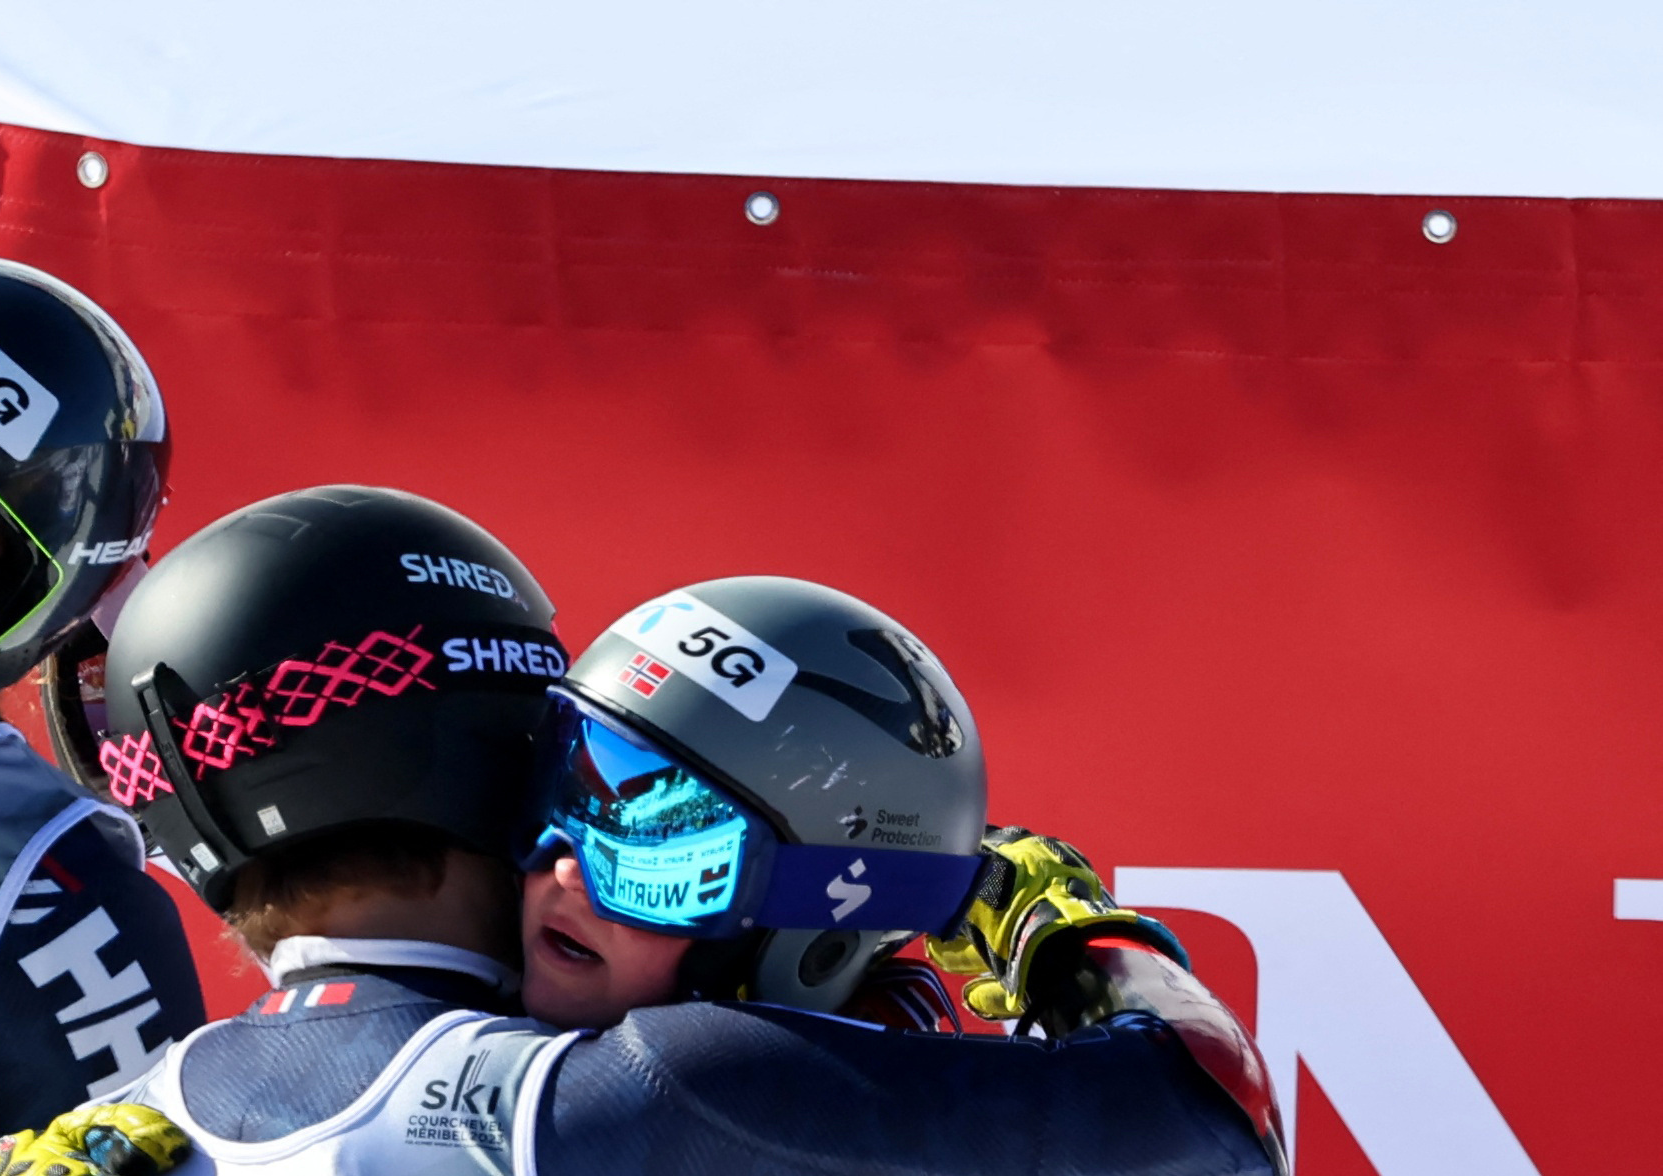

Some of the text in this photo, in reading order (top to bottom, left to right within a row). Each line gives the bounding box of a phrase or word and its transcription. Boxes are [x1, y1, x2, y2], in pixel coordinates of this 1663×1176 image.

[67, 529, 152, 566] HEA
[400, 552, 515, 600] SHRED
[443, 637, 565, 680] SHRED
[677, 625, 766, 690] 5G
[871, 827, 943, 847] Protection
[877, 808, 921, 828] Sweet
[420, 1050, 502, 1116] SKI
